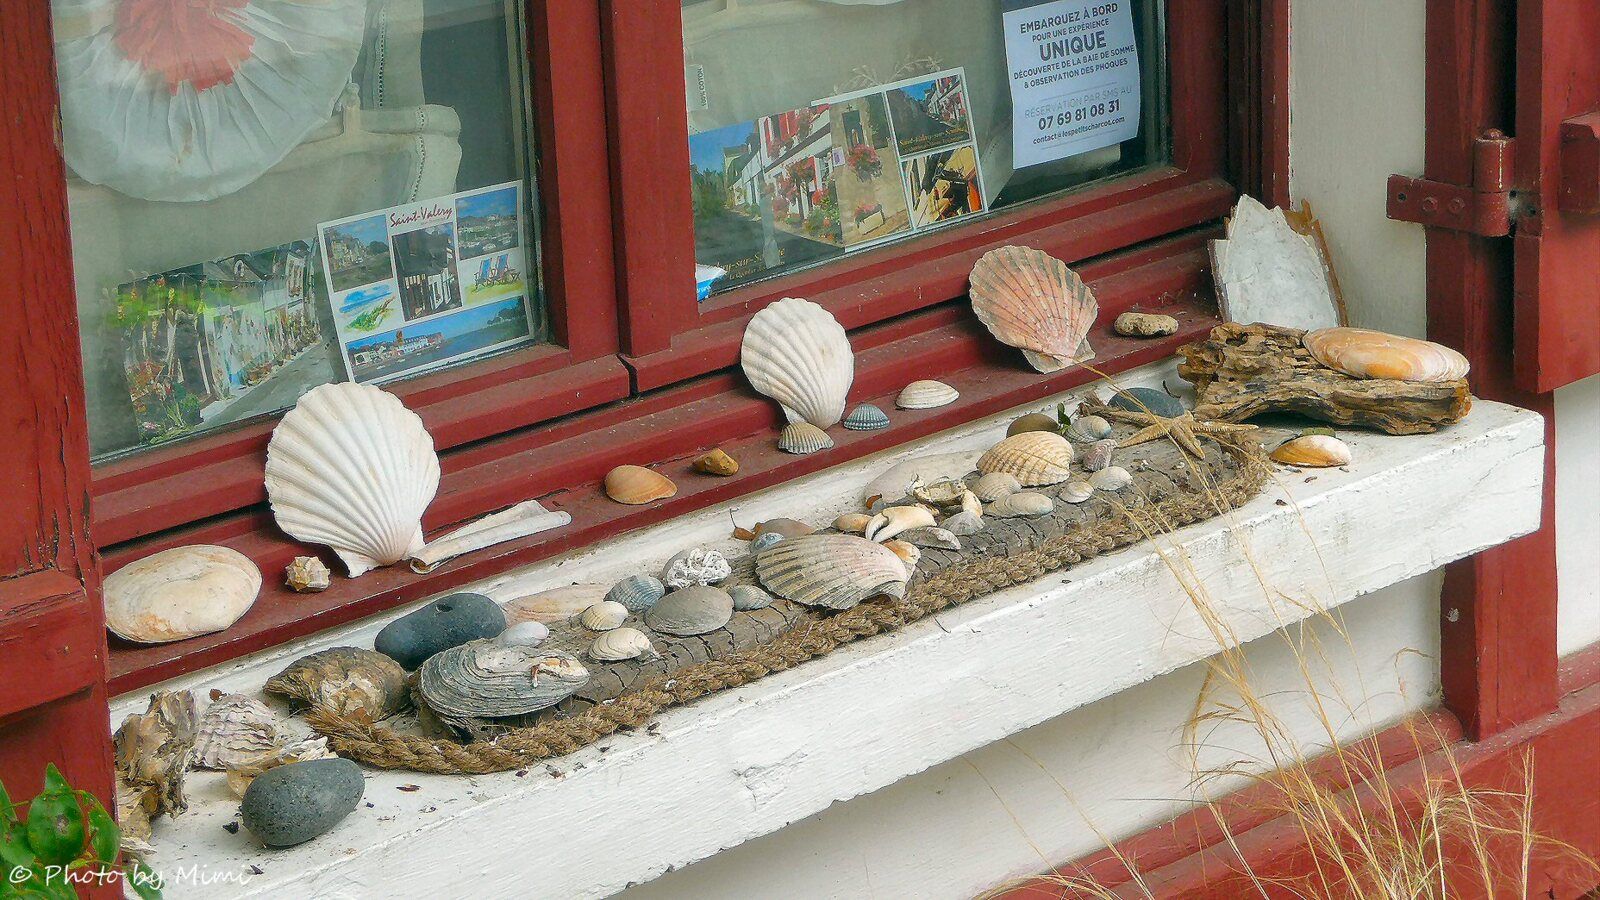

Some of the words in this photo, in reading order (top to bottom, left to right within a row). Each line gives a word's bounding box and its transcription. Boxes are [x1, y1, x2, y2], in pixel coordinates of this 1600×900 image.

[1020, 11, 1080, 33] EMBARQUEZ
[1083, 7, 1091, 19] À
[1092, 3, 1118, 17] BORD
[1032, 32, 1051, 42] POUR
[1052, 28, 1067, 38] UNE
[1040, 31, 1106, 61] UNIQUE
[1014, 62, 1060, 80] DÉCOUVERTE
[1062, 61, 1071, 69] DE
[1072, 58, 1082, 66] LA
[1083, 53, 1098, 64] BAIE
[1100, 50, 1110, 59] DE
[1111, 45, 1135, 57] SOMME
[1030, 69, 1080, 87] OBSERVATION
[1080, 66, 1095, 76] DES
[1095, 58, 1128, 72] PHOQUES
[1084, 91, 1101, 103] PAR
[1102, 88, 1119, 100] SMS
[1121, 85, 1132, 96] AU
[1039, 115, 1054, 131] 07
[1057, 111, 1072, 126] 69
[1075, 107, 1087, 122] 81
[1090, 103, 1105, 118] 08
[1108, 99, 1120, 112] 31
[390, 204, 452, 227] Saint-Valery
